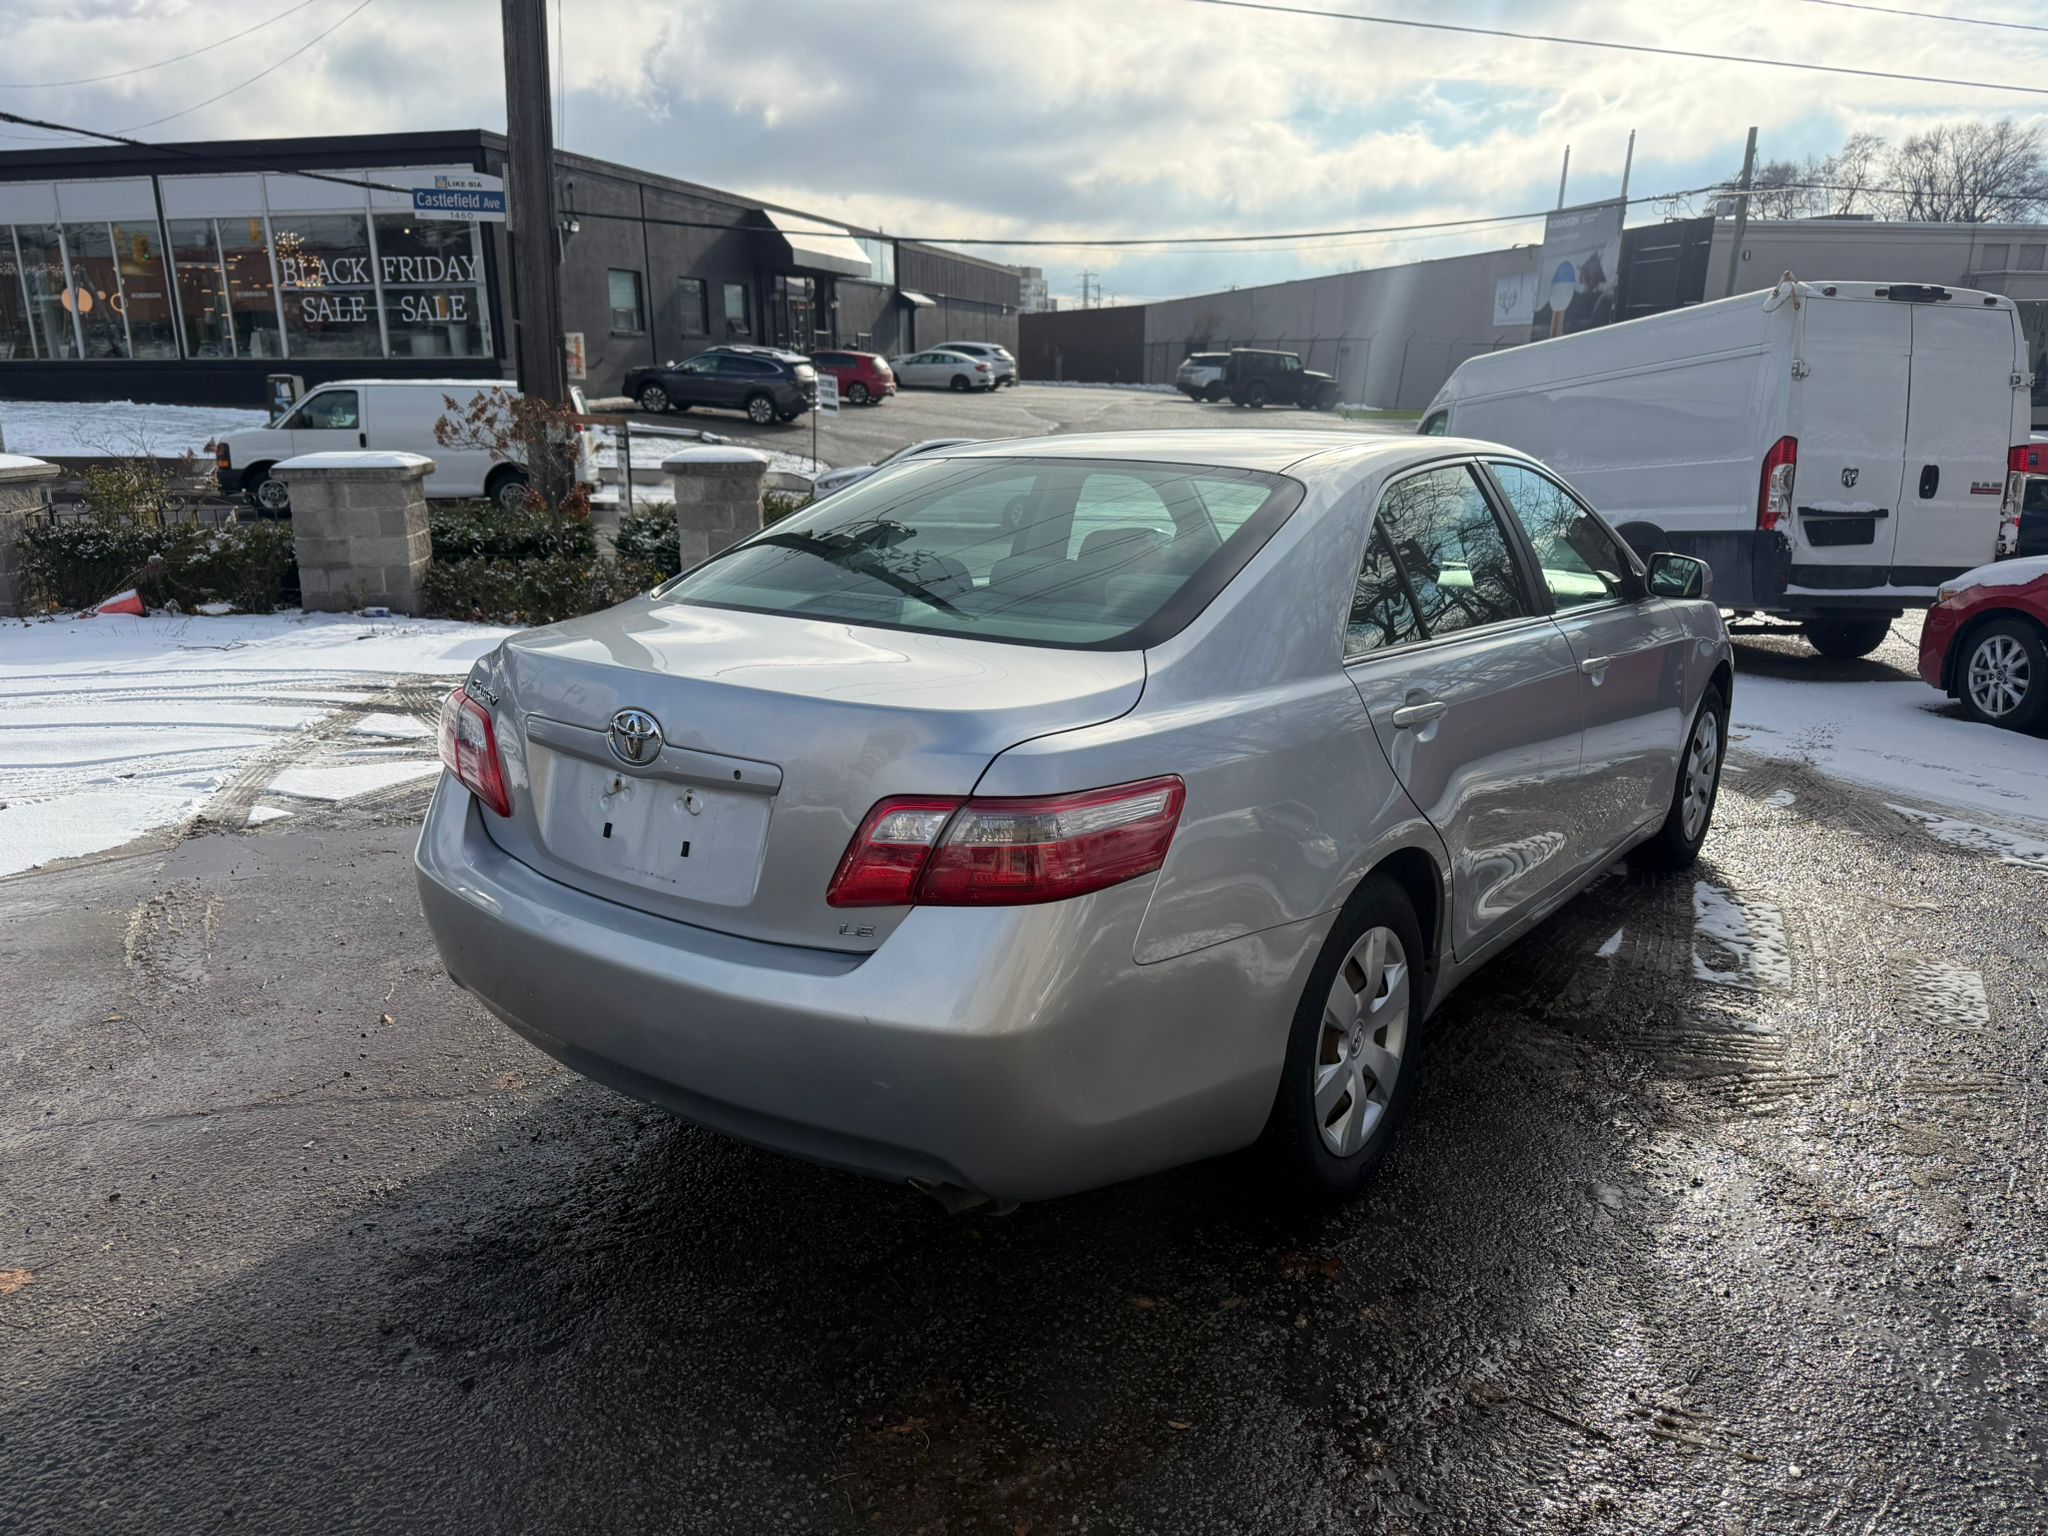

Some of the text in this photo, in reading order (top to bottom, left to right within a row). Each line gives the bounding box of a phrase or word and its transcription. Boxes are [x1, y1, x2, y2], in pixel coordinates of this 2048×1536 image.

[416, 192, 501, 209] Castlefield Ave
[450, 211, 474, 220] 1460
[282, 255, 479, 284] BLACK FRIDAY
[302, 297, 367, 322] SALE
[401, 295, 467, 322] SALE
[839, 923, 876, 937] LE
